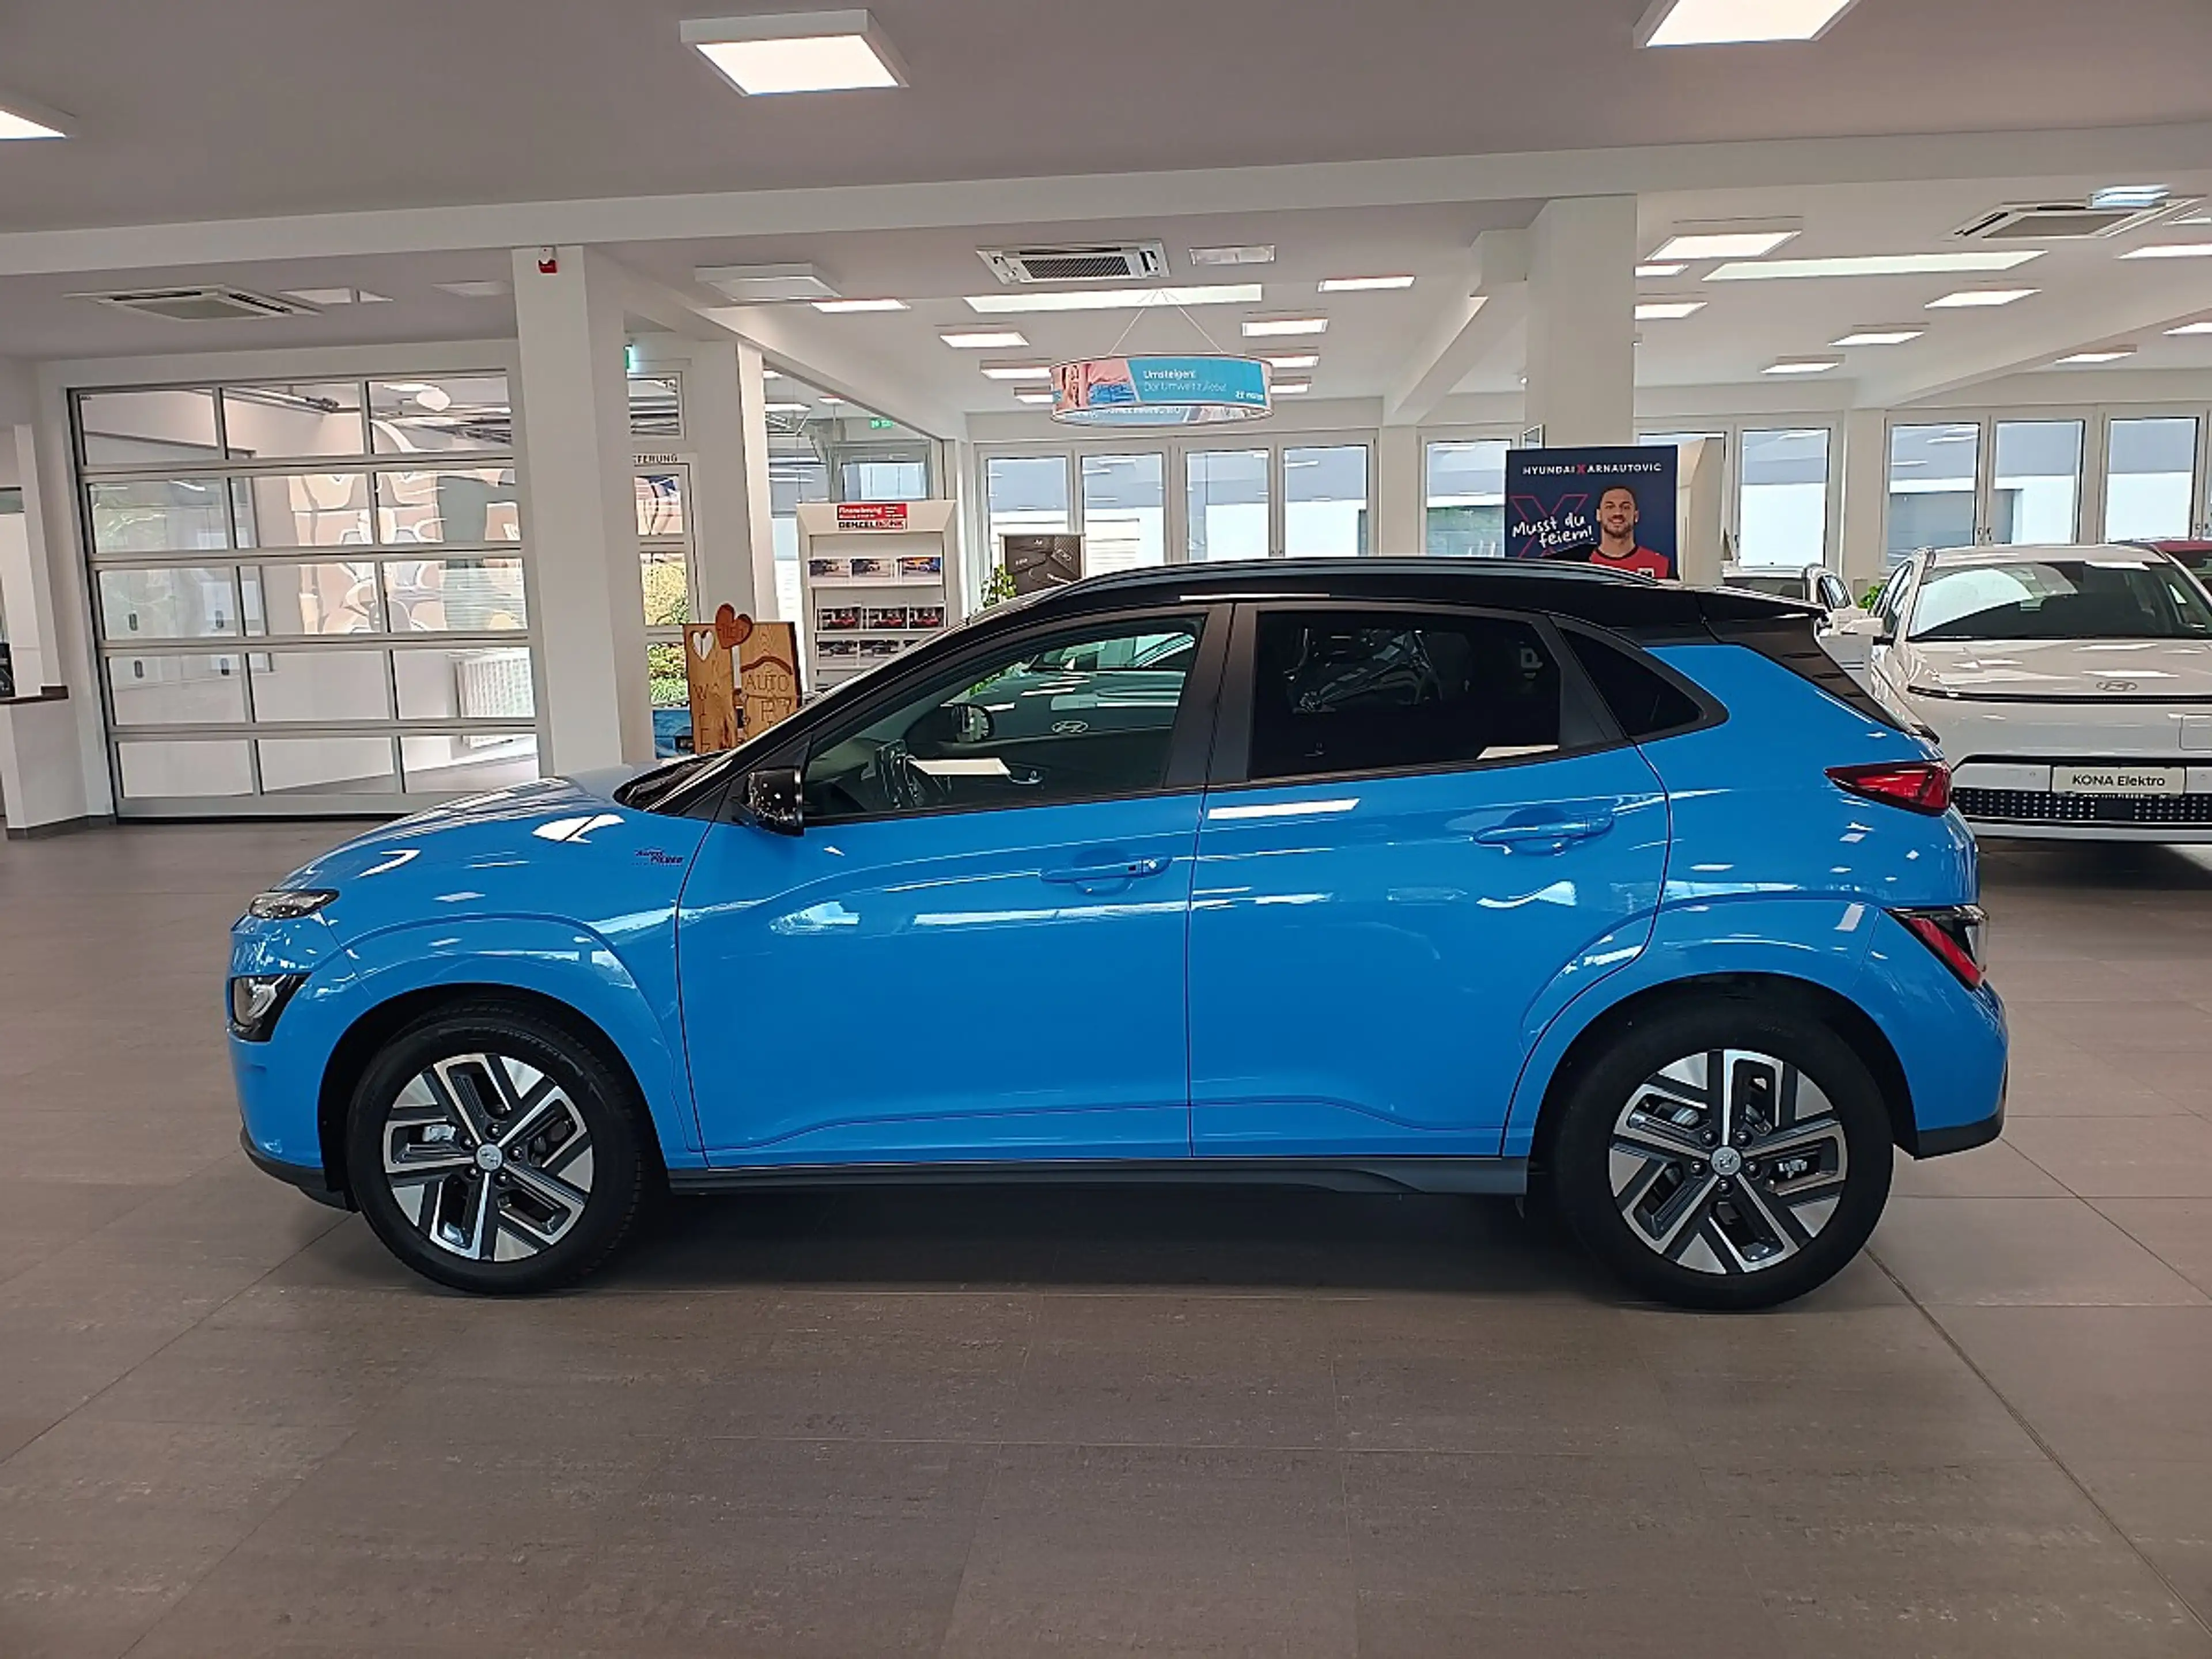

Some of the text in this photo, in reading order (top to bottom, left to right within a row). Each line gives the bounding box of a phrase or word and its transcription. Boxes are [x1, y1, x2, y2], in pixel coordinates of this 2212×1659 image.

[1522, 465, 1575, 475] HYUNDAI
[1512, 512, 1585, 537] Musst du
[1539, 525, 1594, 548] feiern!
[744, 674, 790, 692] AUTO
[2071, 774, 2165, 786] KONA Elektro
